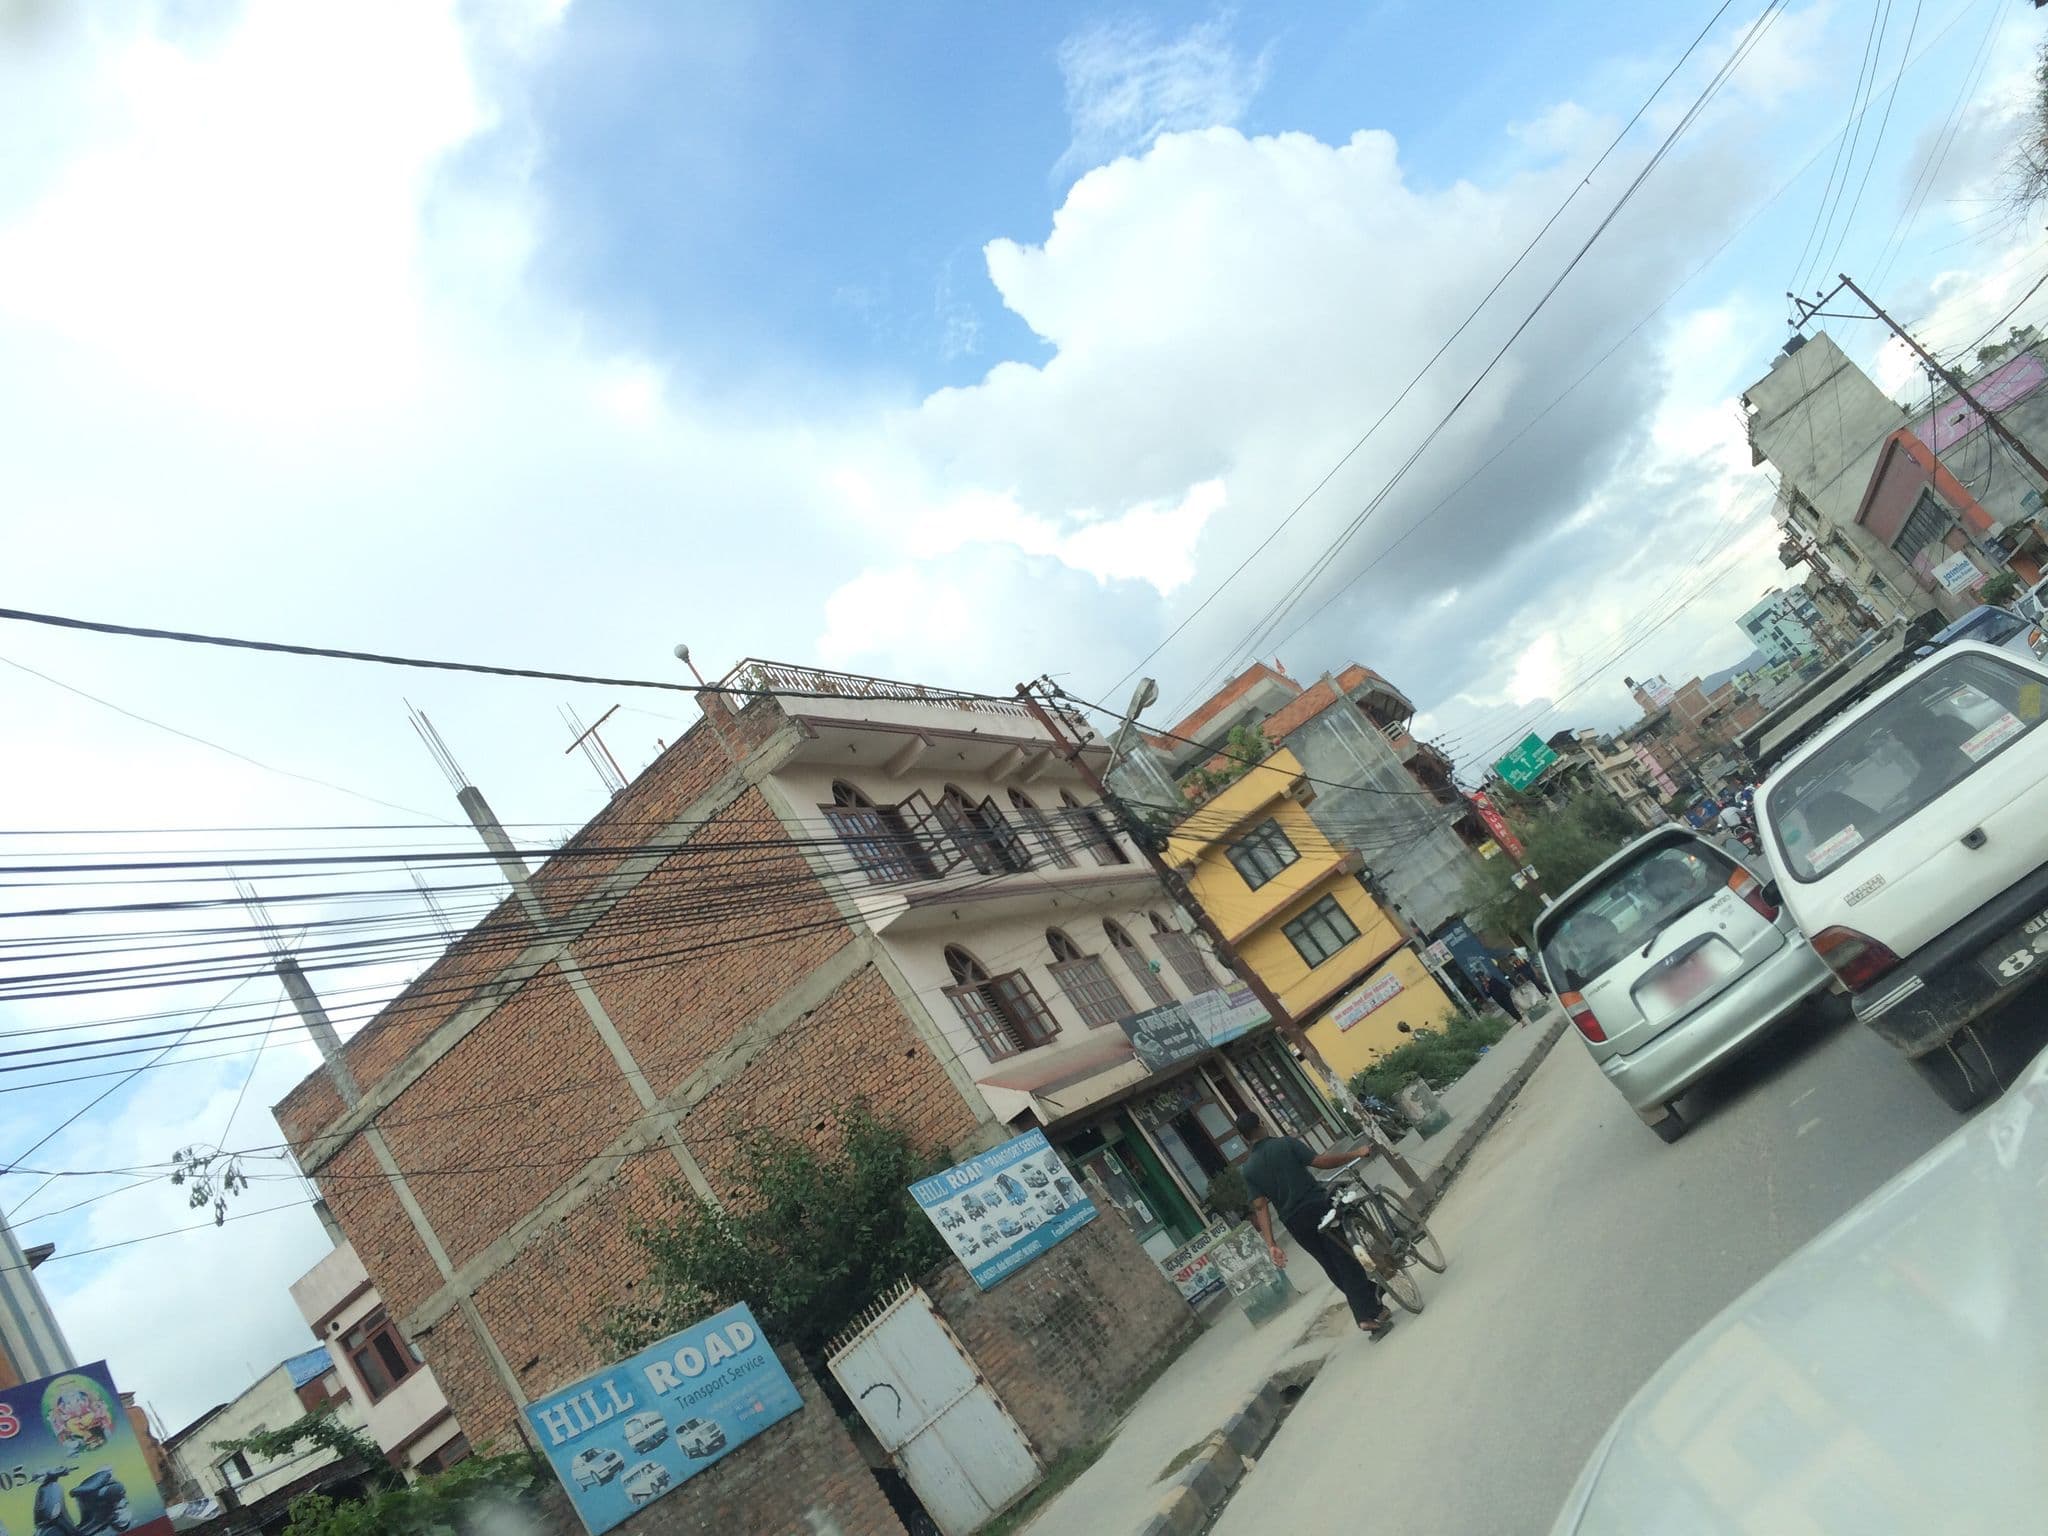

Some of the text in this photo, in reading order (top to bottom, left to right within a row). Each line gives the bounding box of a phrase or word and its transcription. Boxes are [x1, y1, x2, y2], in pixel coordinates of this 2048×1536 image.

[917, 1174, 950, 1204] HILL
[537, 1379, 635, 1446] HILL
[643, 1320, 756, 1396] ROAD
[674, 1374, 728, 1411] Transport
[727, 1353, 766, 1386] Service
